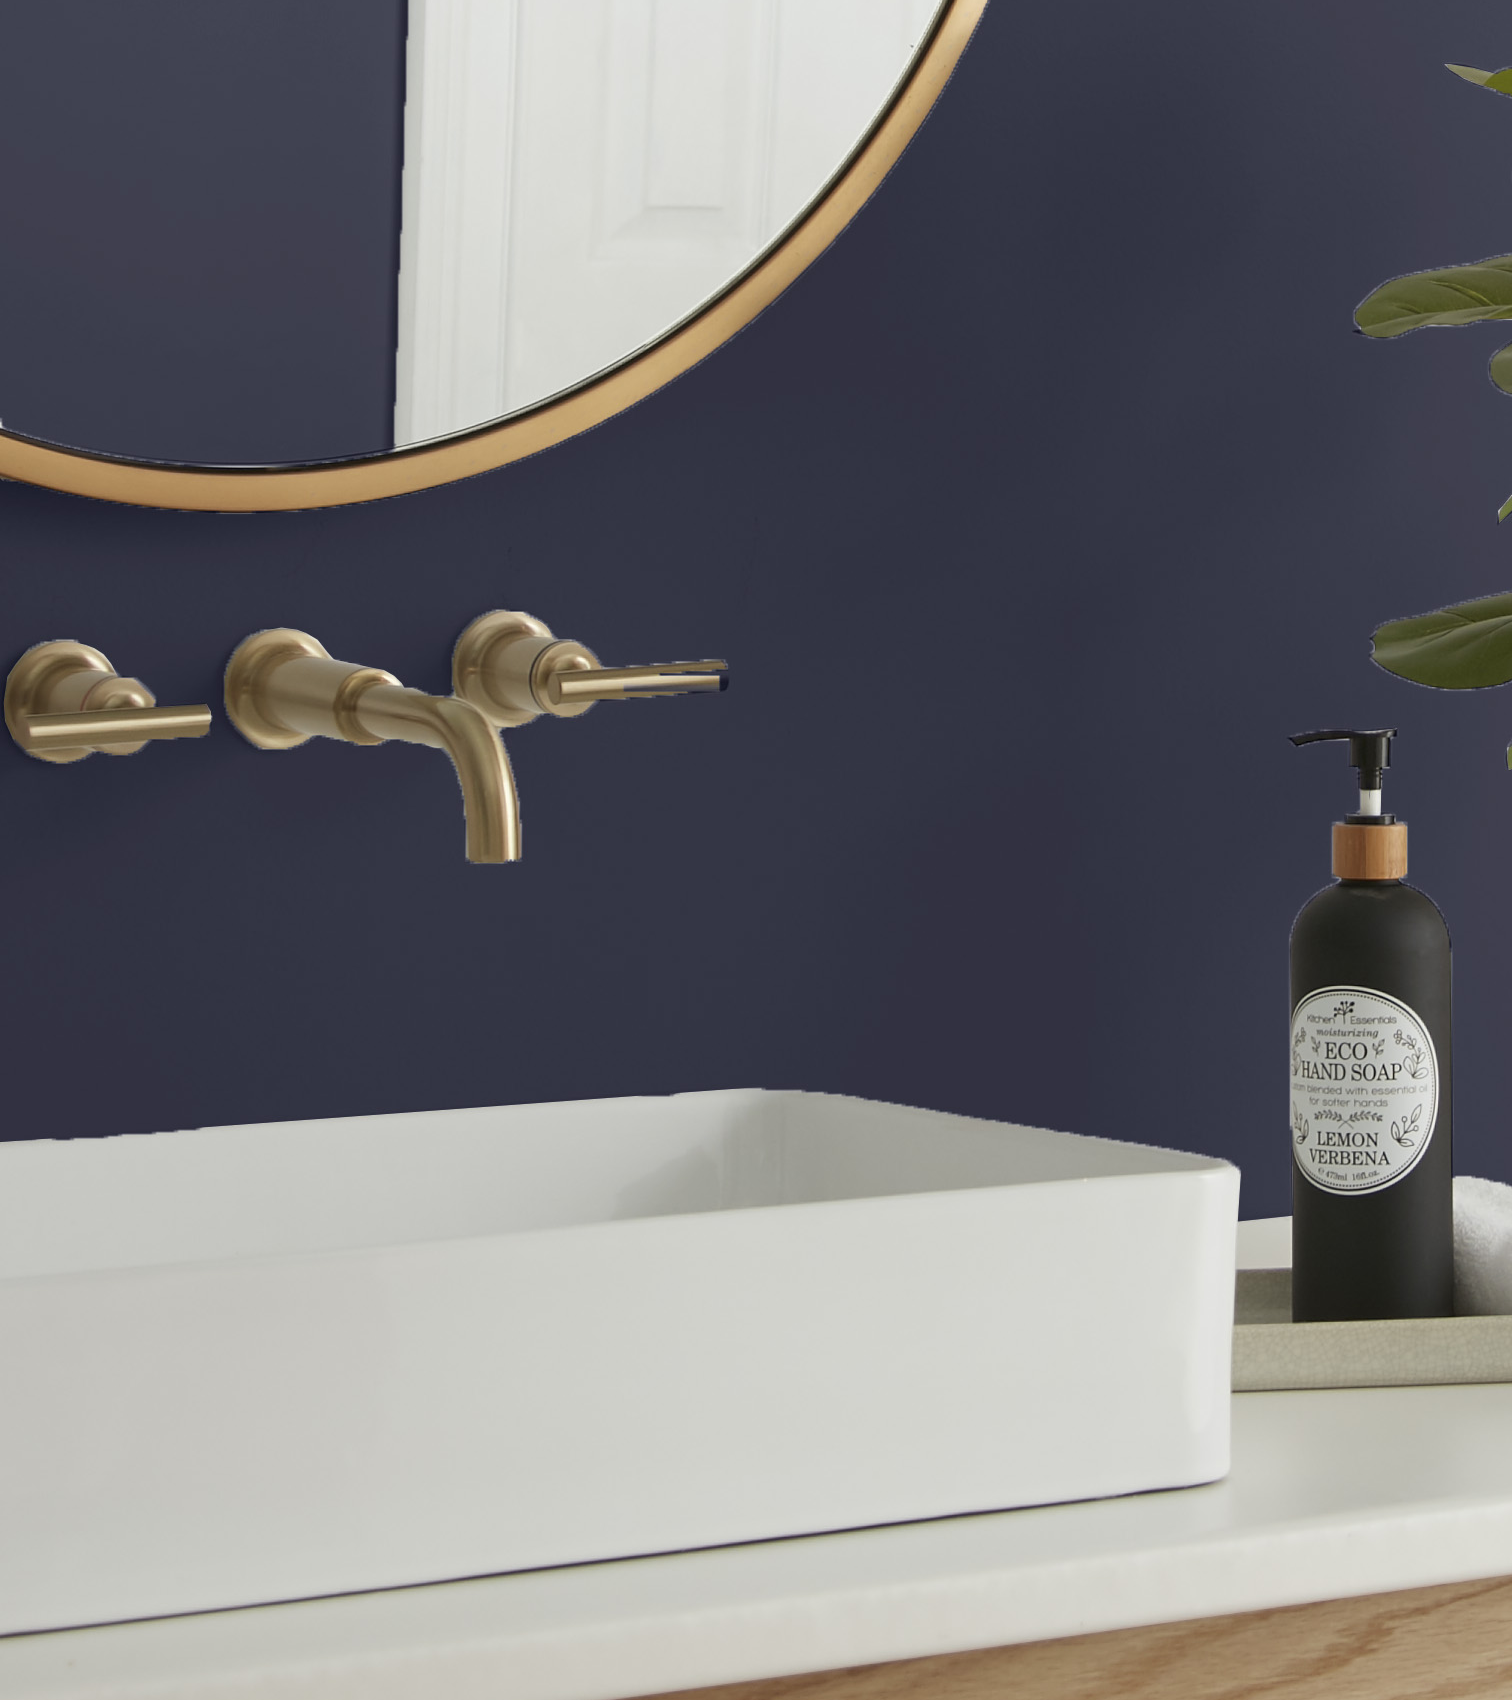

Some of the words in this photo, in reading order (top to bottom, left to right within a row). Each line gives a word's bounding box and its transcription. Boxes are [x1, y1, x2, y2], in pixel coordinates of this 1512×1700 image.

[1307, 1014, 1335, 1024] Kitchen
[1350, 1015, 1397, 1025] Essentials
[1316, 1027, 1379, 1039] moisturizing
[1325, 1042, 1368, 1060] ECO
[1301, 1060, 1346, 1081] HAND
[1351, 1062, 1403, 1082] SOAP
[1306, 1084, 1342, 1095] blended
[1345, 1086, 1368, 1096] with
[1371, 1085, 1417, 1096] essential
[1309, 1096, 1319, 1106] for
[1322, 1097, 1350, 1107] softer
[1353, 1097, 1388, 1108] hands
[1317, 1131, 1379, 1147] LEMON
[1309, 1150, 1391, 1166] VERBENA
